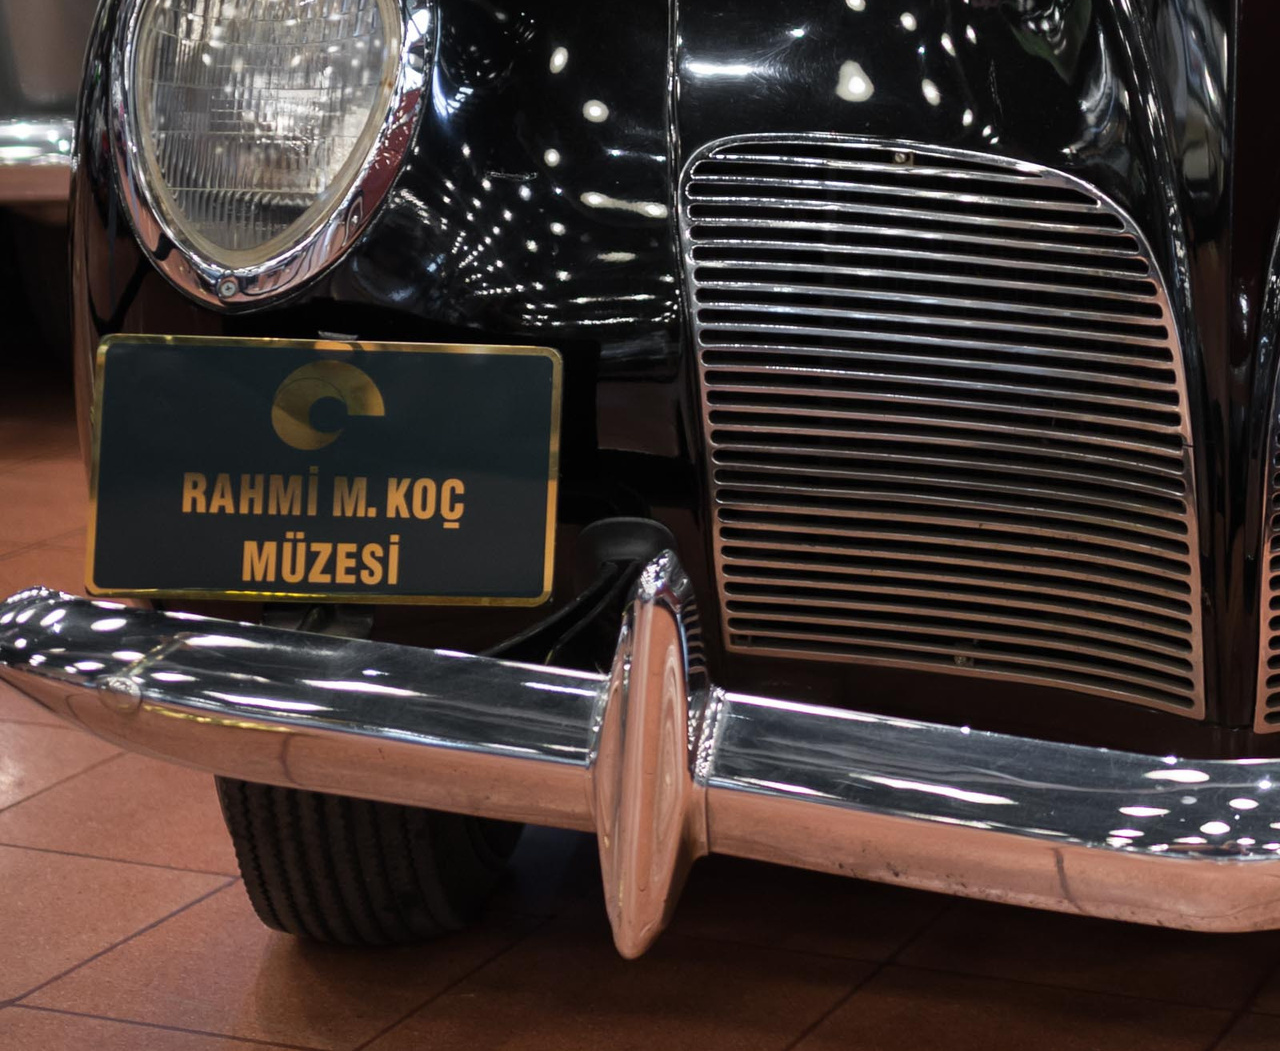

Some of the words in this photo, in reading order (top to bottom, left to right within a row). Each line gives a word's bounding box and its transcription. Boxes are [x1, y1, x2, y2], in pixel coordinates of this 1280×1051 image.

[181, 465, 319, 516] RAHMİ
[332, 476, 377, 518] M.
[386, 477, 466, 530] KOÇ
[241, 531, 400, 586] MÜZESİ
